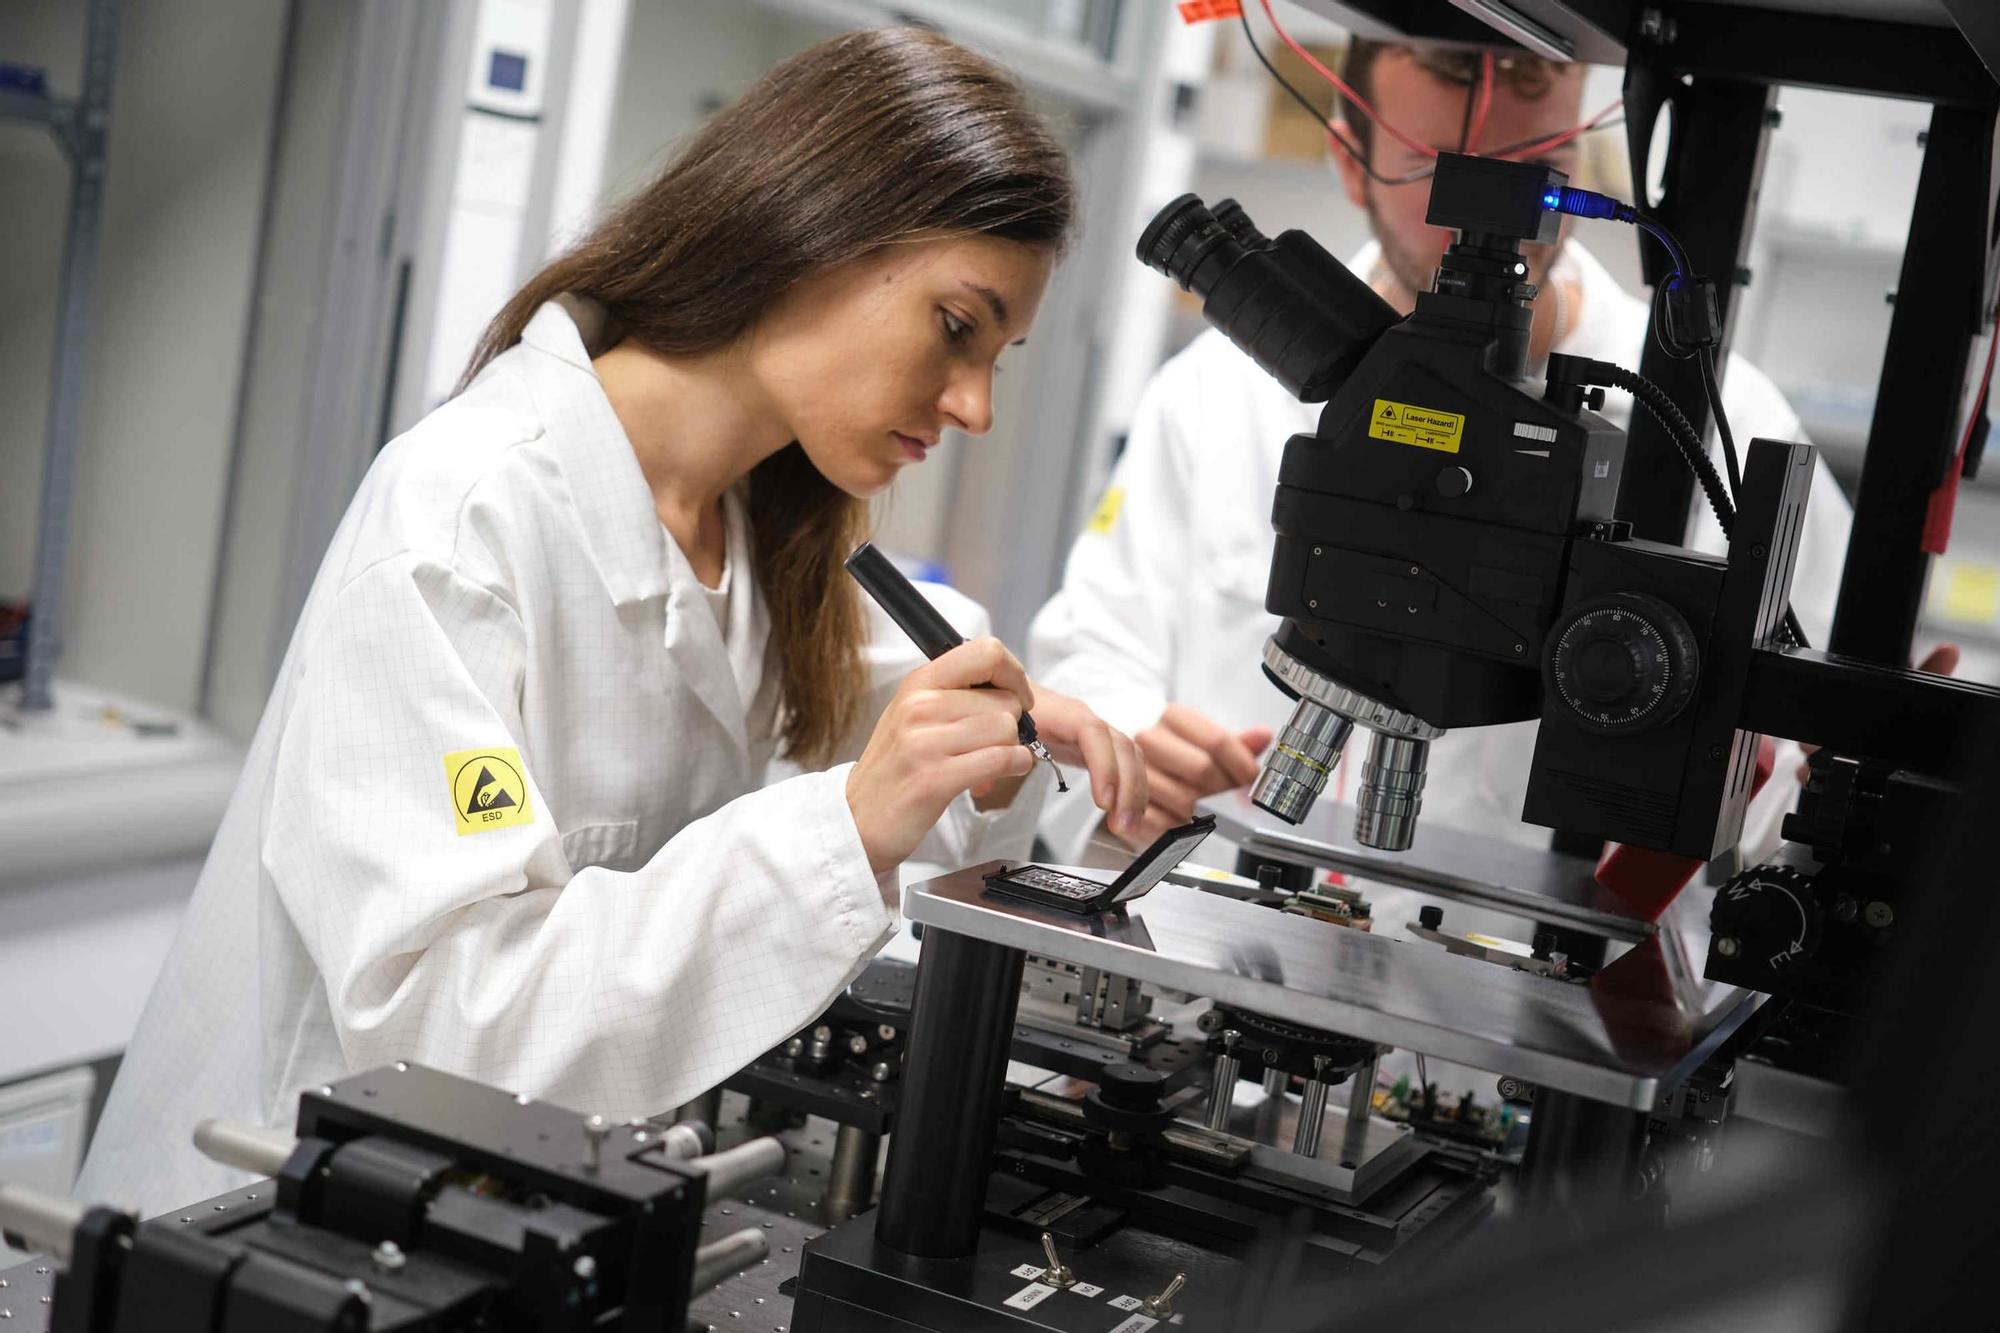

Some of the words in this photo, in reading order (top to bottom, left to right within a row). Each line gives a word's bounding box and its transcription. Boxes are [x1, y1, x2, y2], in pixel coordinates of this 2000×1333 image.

[1406, 412, 1426, 423] Laser
[1427, 416, 1455, 428] Hazard!
[1639, 626, 1649, 636] 70
[1656, 653, 1664, 662] 60
[481, 811, 503, 822] ESD
[1769, 951, 1791, 969] E
